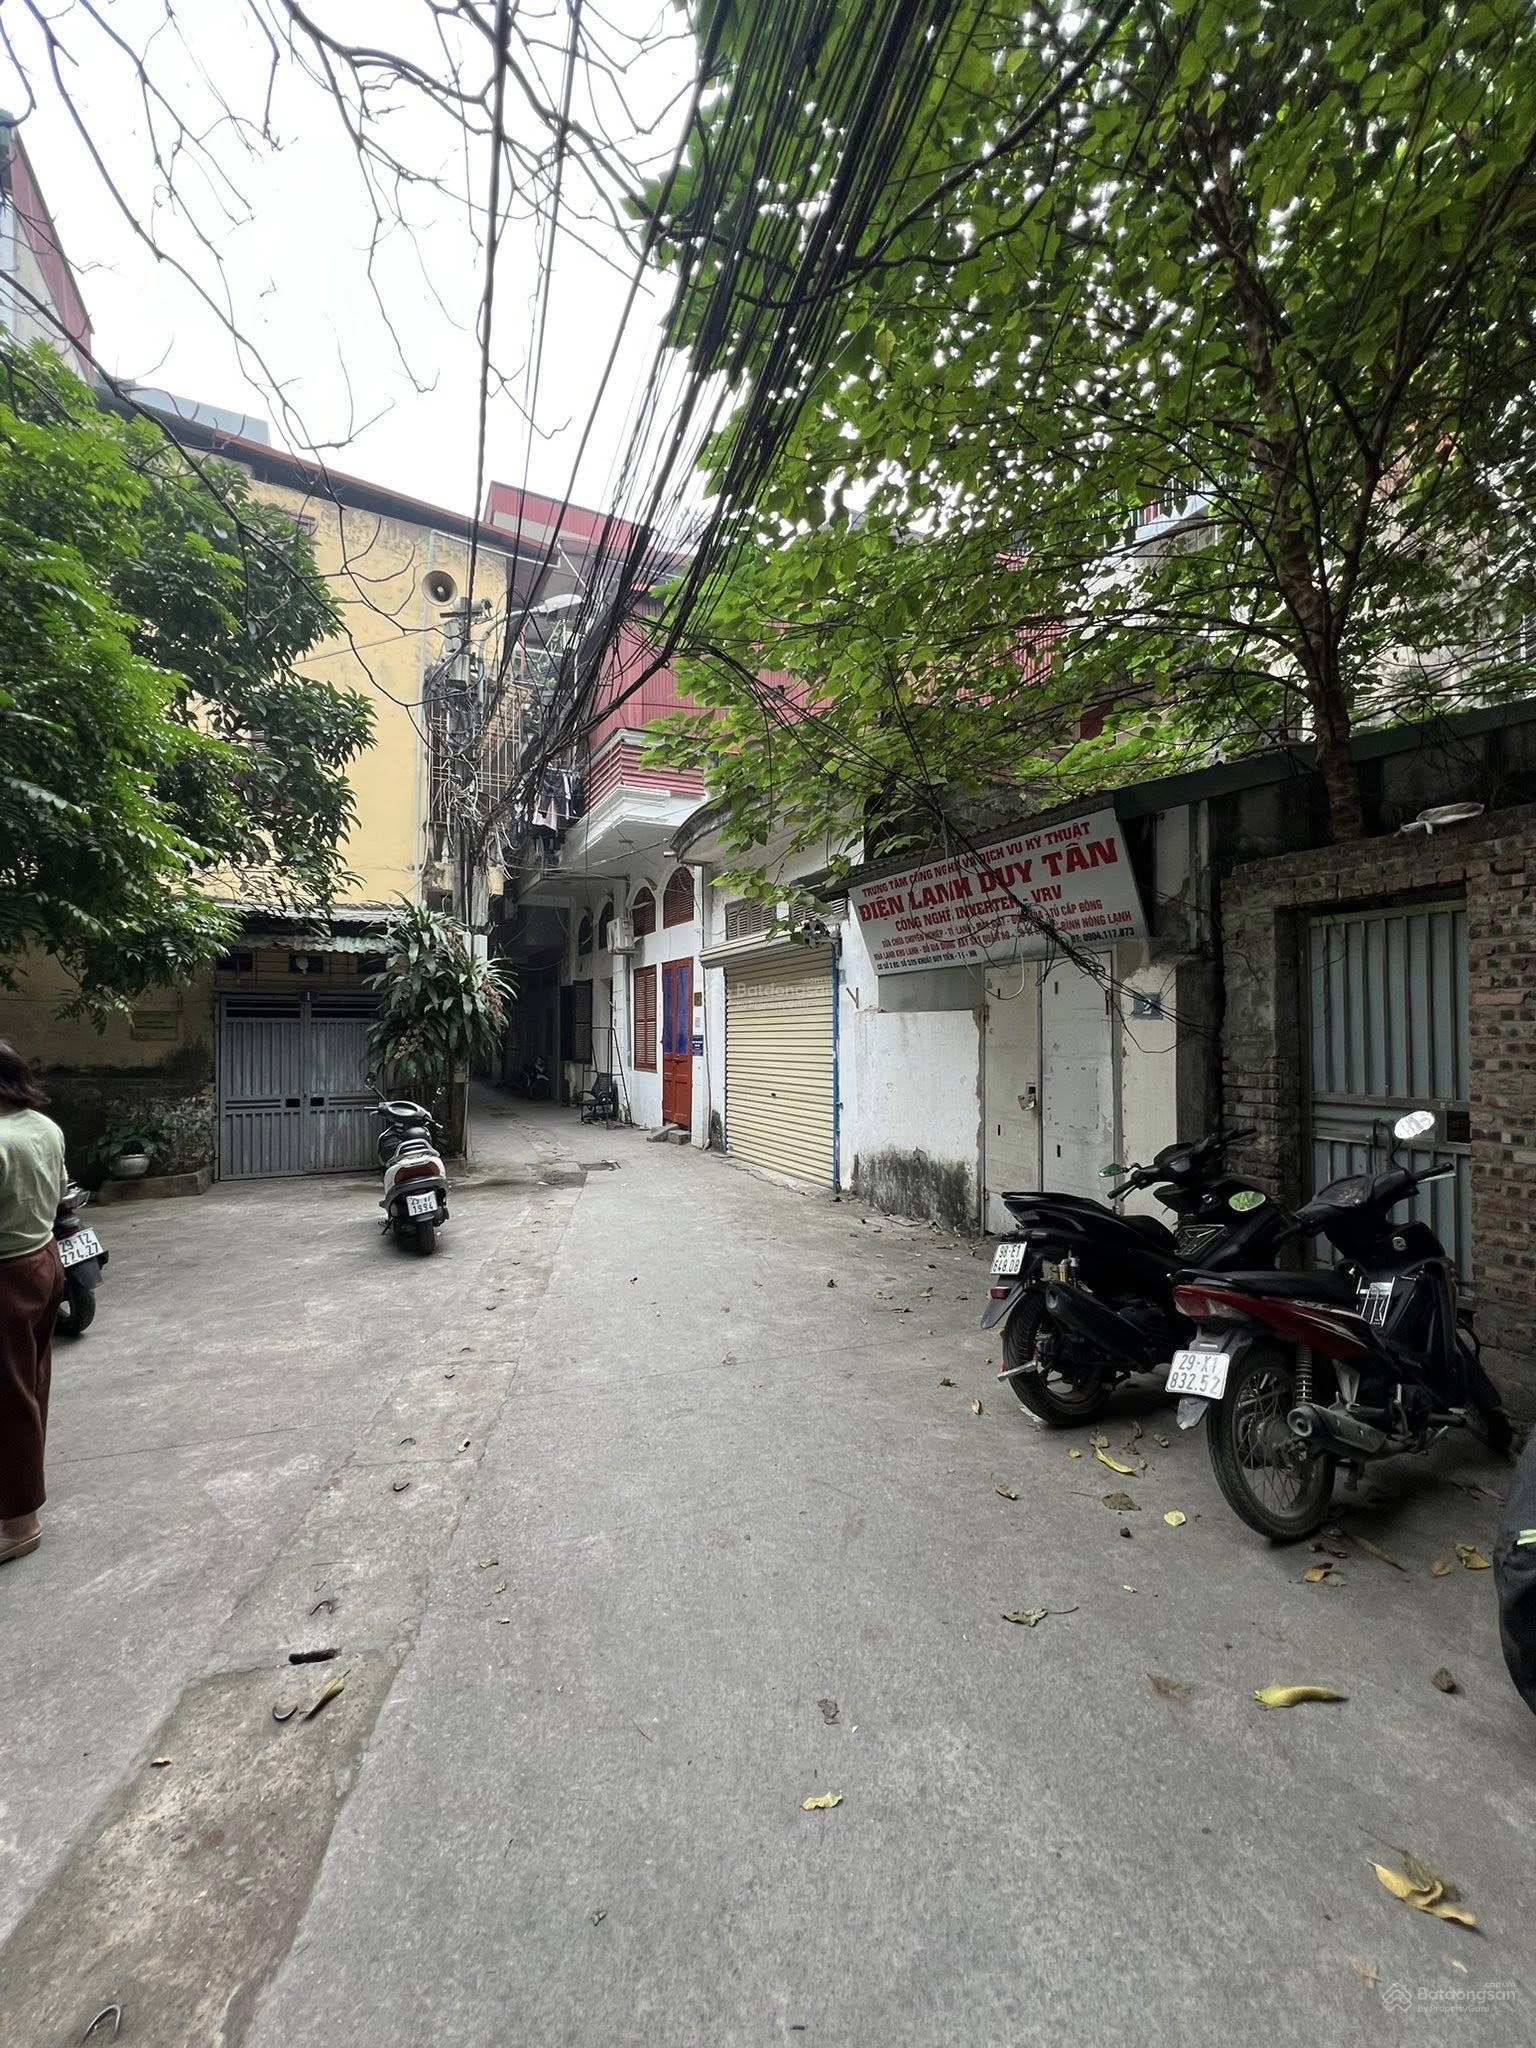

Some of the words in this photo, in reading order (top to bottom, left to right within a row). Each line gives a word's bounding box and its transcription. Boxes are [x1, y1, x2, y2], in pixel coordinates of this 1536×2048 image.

[858, 895, 905, 921] ĐIỆN
[907, 877, 973, 910] LẠNH
[979, 859, 1032, 893] DUY
[1041, 837, 1118, 876] TÂN
[862, 883, 888, 897] TRUNG
[889, 876, 908, 889] TÂM
[1044, 822, 1090, 843] THUẬT
[895, 914, 921, 931] CÔNG
[955, 896, 1017, 919] INVERTER
[1031, 884, 1062, 904] VRV
[1107, 911, 1133, 926] LẠNH
[1170, 1372, 1220, 1394] 832.52
